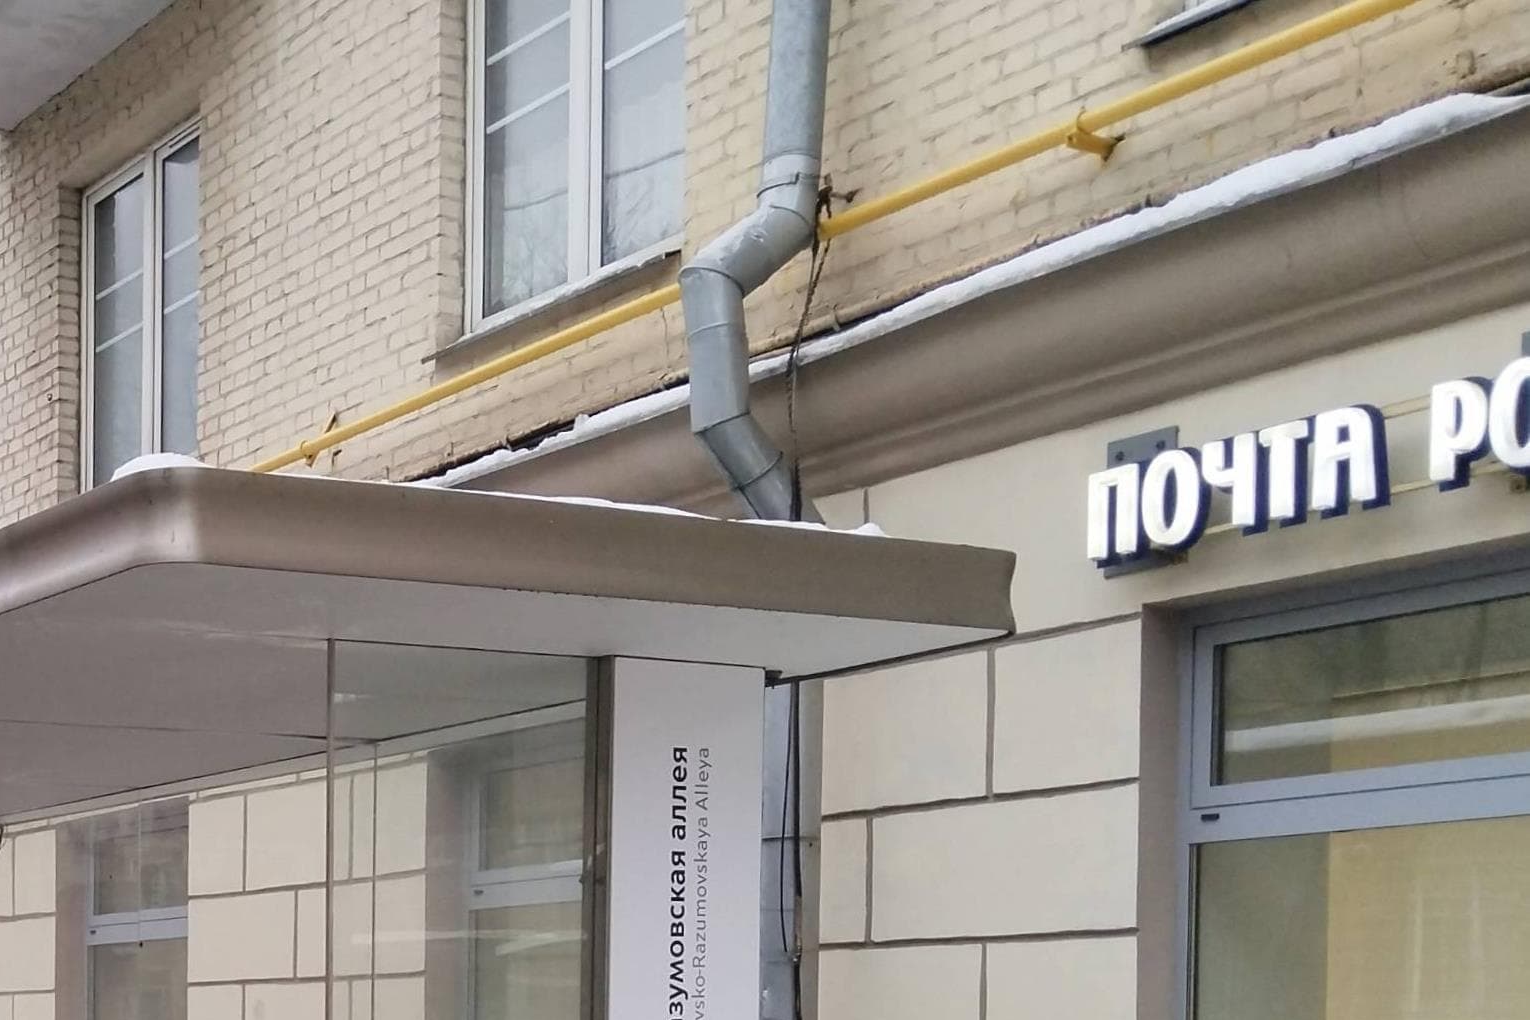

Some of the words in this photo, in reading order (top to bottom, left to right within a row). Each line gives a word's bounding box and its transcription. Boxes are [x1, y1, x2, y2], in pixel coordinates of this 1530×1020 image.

[1087, 405, 1387, 565] ПОЧТА
[671, 747, 688, 840] аллея
[694, 748, 712, 811] Alleya
